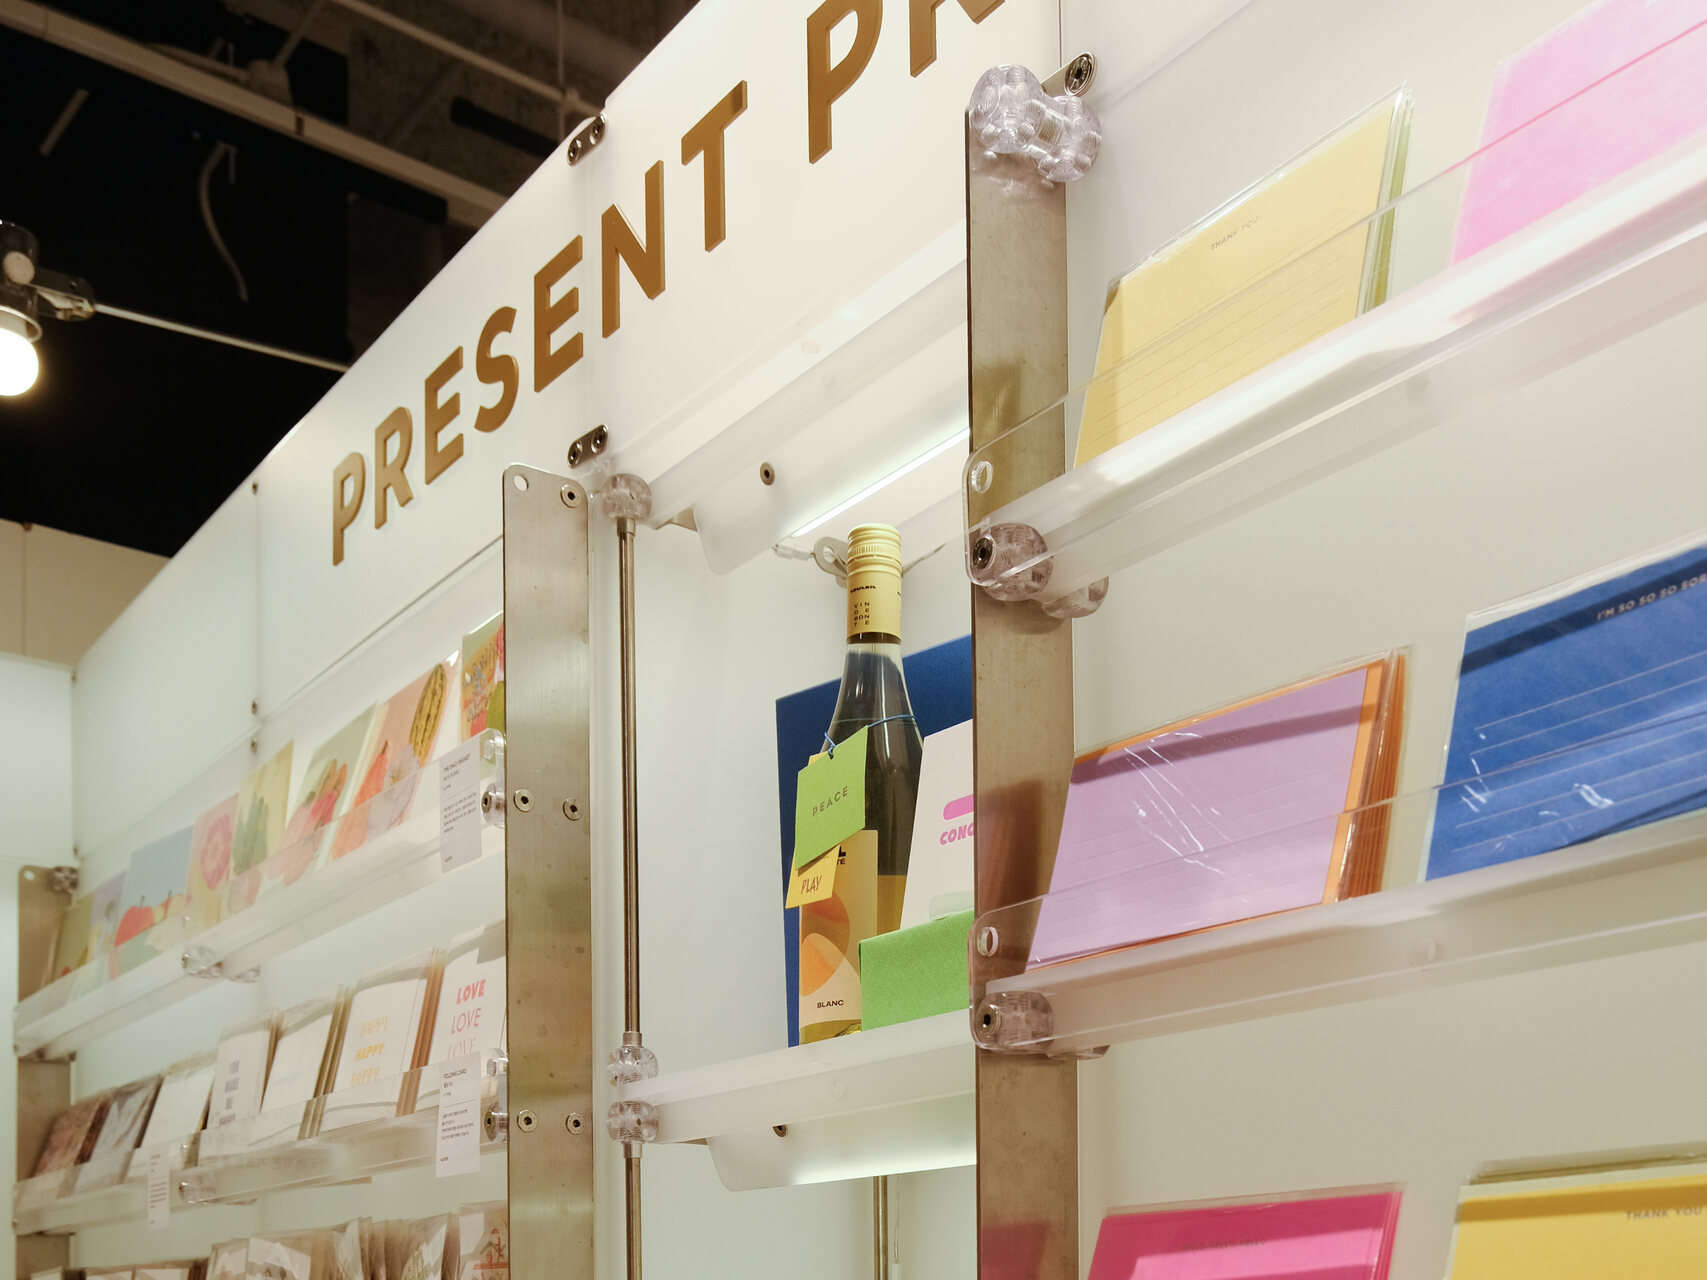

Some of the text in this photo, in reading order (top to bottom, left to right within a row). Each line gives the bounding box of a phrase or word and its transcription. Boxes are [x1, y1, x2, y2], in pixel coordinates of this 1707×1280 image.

[331, 79, 748, 566] PRESENT
[1618, 600, 1636, 614] SO
[1638, 592, 1657, 606] SO
[1659, 585, 1678, 599] SO
[812, 786, 848, 817] PEACE
[800, 875, 822, 895] PLAY
[456, 979, 487, 1005] LOVE
[816, 999, 845, 1009] BLANC
[451, 1007, 482, 1034] LOVE
[1625, 1208, 1669, 1220] THANK
